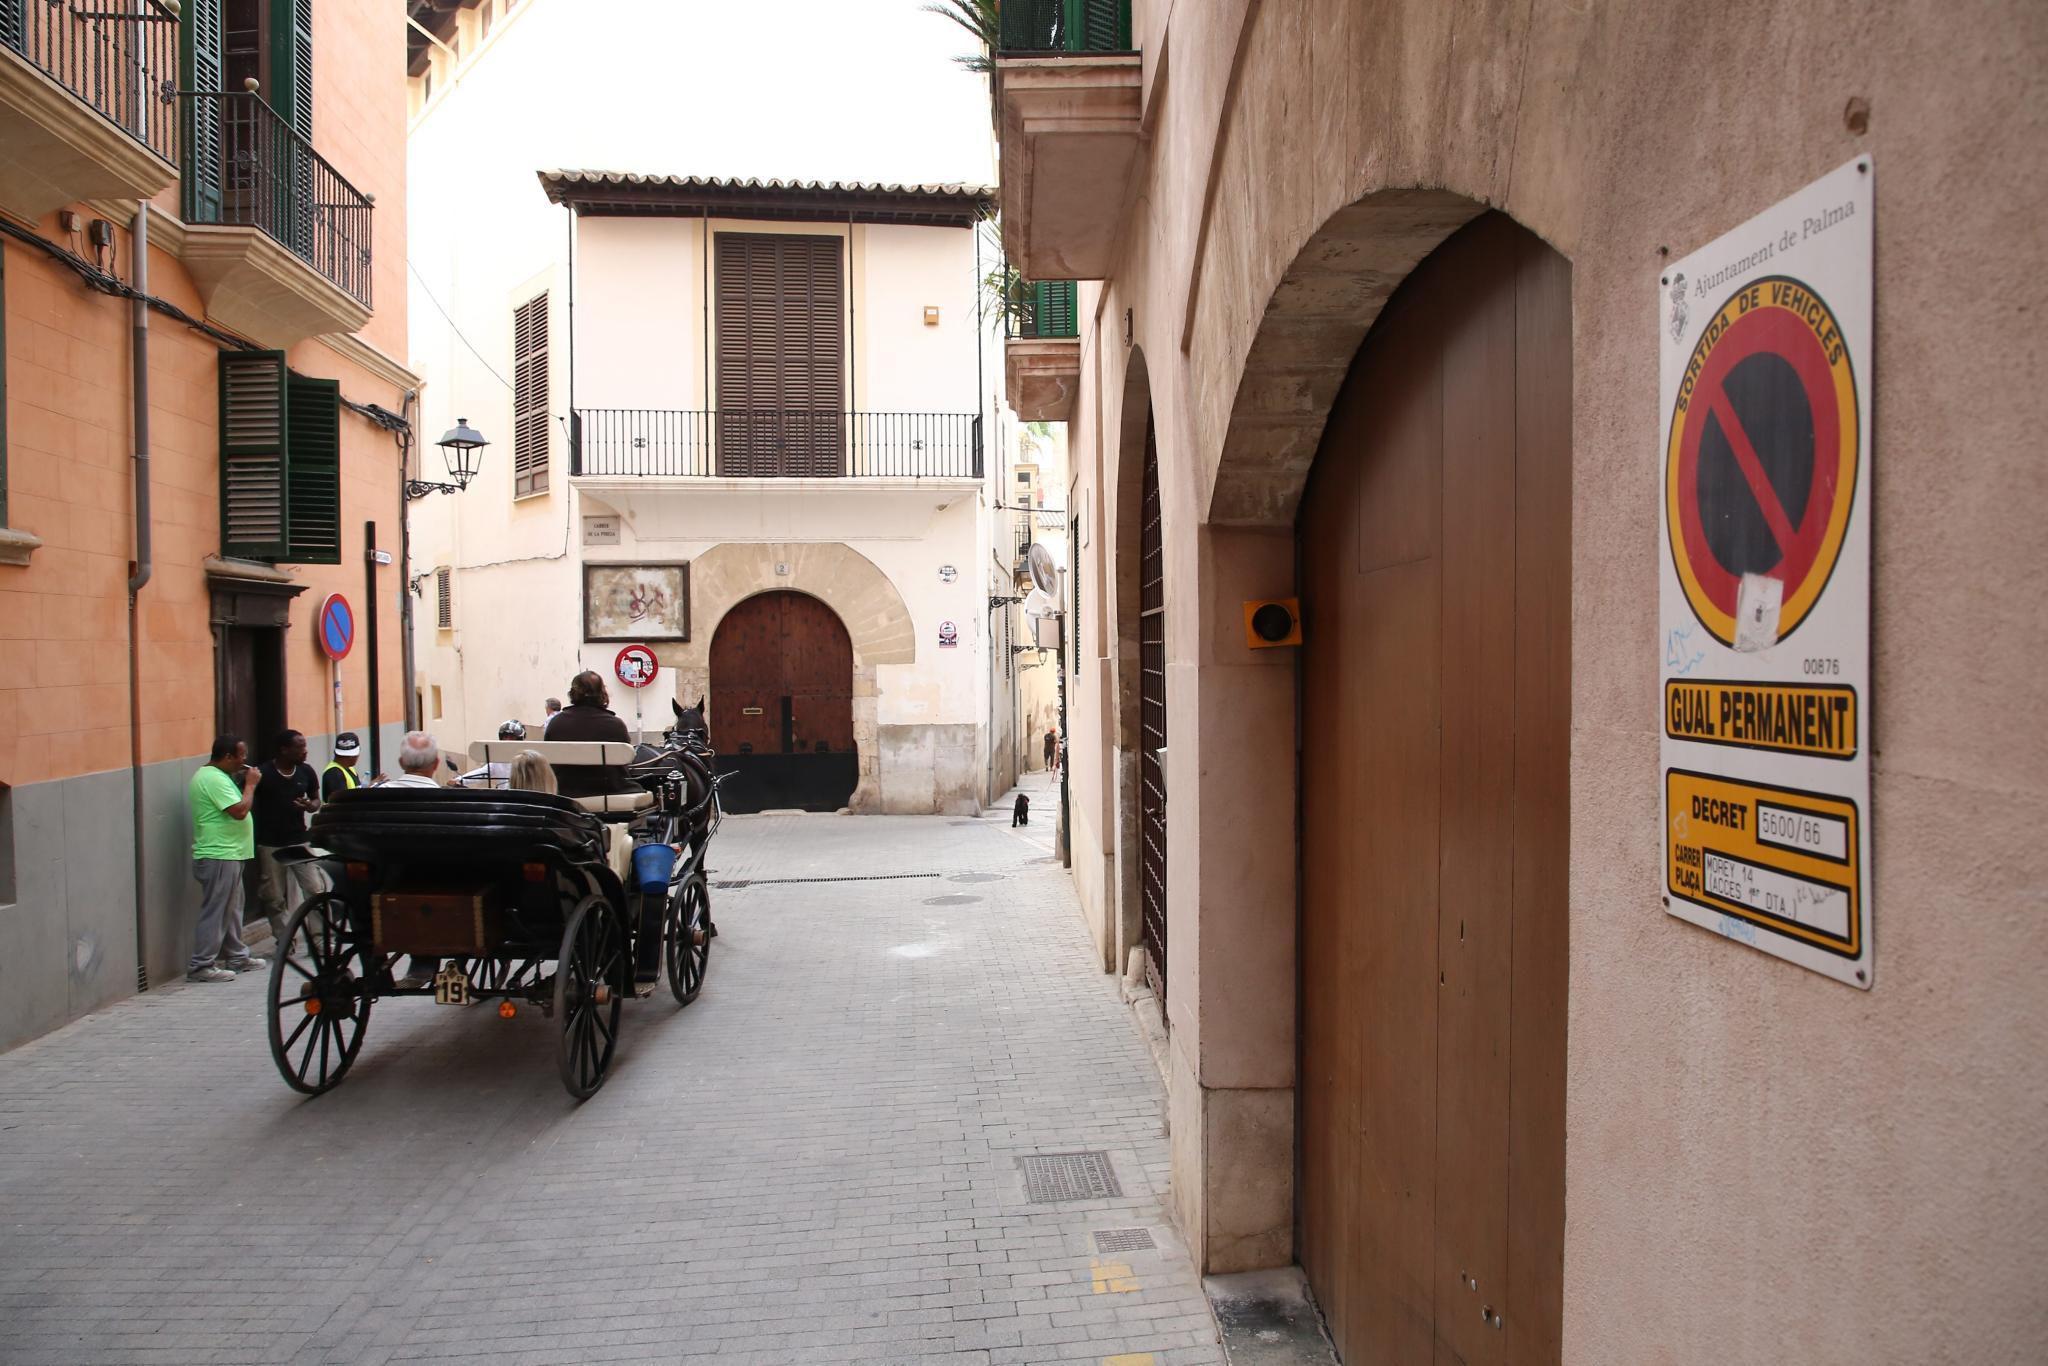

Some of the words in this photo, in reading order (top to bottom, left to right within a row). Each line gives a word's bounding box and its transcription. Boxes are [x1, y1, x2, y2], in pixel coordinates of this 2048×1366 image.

[1694, 242, 1775, 299] Ajuntament
[1778, 230, 1798, 252] de
[1802, 200, 1856, 240] Palma
[1678, 313, 1730, 413] SORTIDA
[1738, 287, 1761, 314] DE
[1771, 283, 1843, 367] VEHICLES
[1803, 658, 1840, 676] 00876
[1671, 687, 1715, 736] GUAL
[1720, 690, 1849, 750] PERMANENT
[1692, 795, 1747, 831] DECRET
[1762, 812, 1821, 847] 5600/86
[1675, 844, 1701, 867] CARRER
[1706, 856, 1736, 878] MOREY
[1742, 868, 1754, 882] 14
[1675, 867, 1701, 897] PLAÇA
[441, 981, 463, 1003] 19
